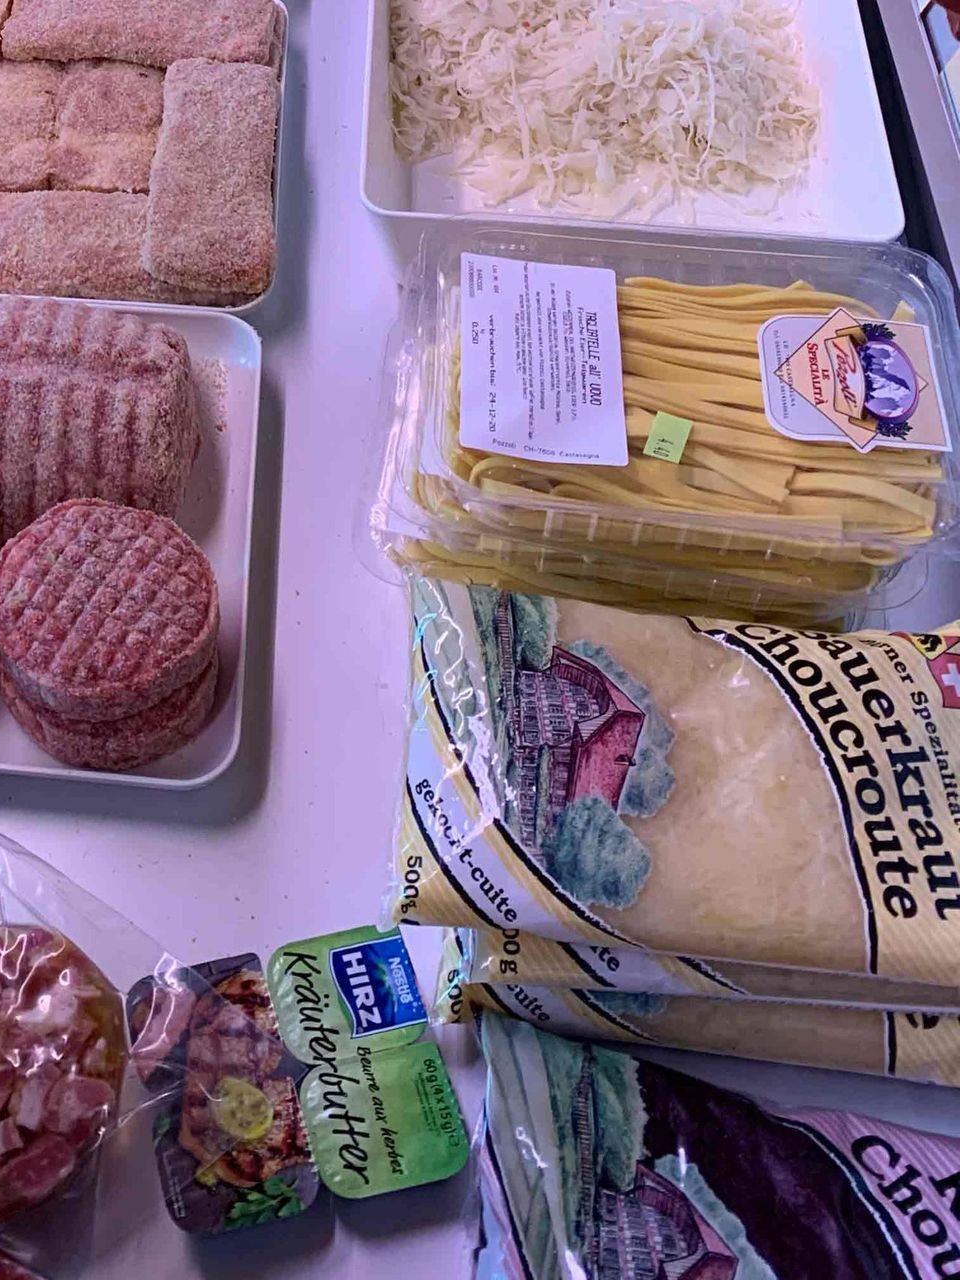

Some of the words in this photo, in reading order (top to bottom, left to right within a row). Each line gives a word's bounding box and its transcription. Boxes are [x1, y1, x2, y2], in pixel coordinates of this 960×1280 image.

[734, 623, 917, 919] Choucroute
[283, 951, 371, 1186] Kräuterbutter
[342, 951, 383, 1027] HIRZ
[355, 1046, 381, 1095] Beurre
[372, 1096, 388, 1124] aux
[380, 1125, 405, 1175] herbes
